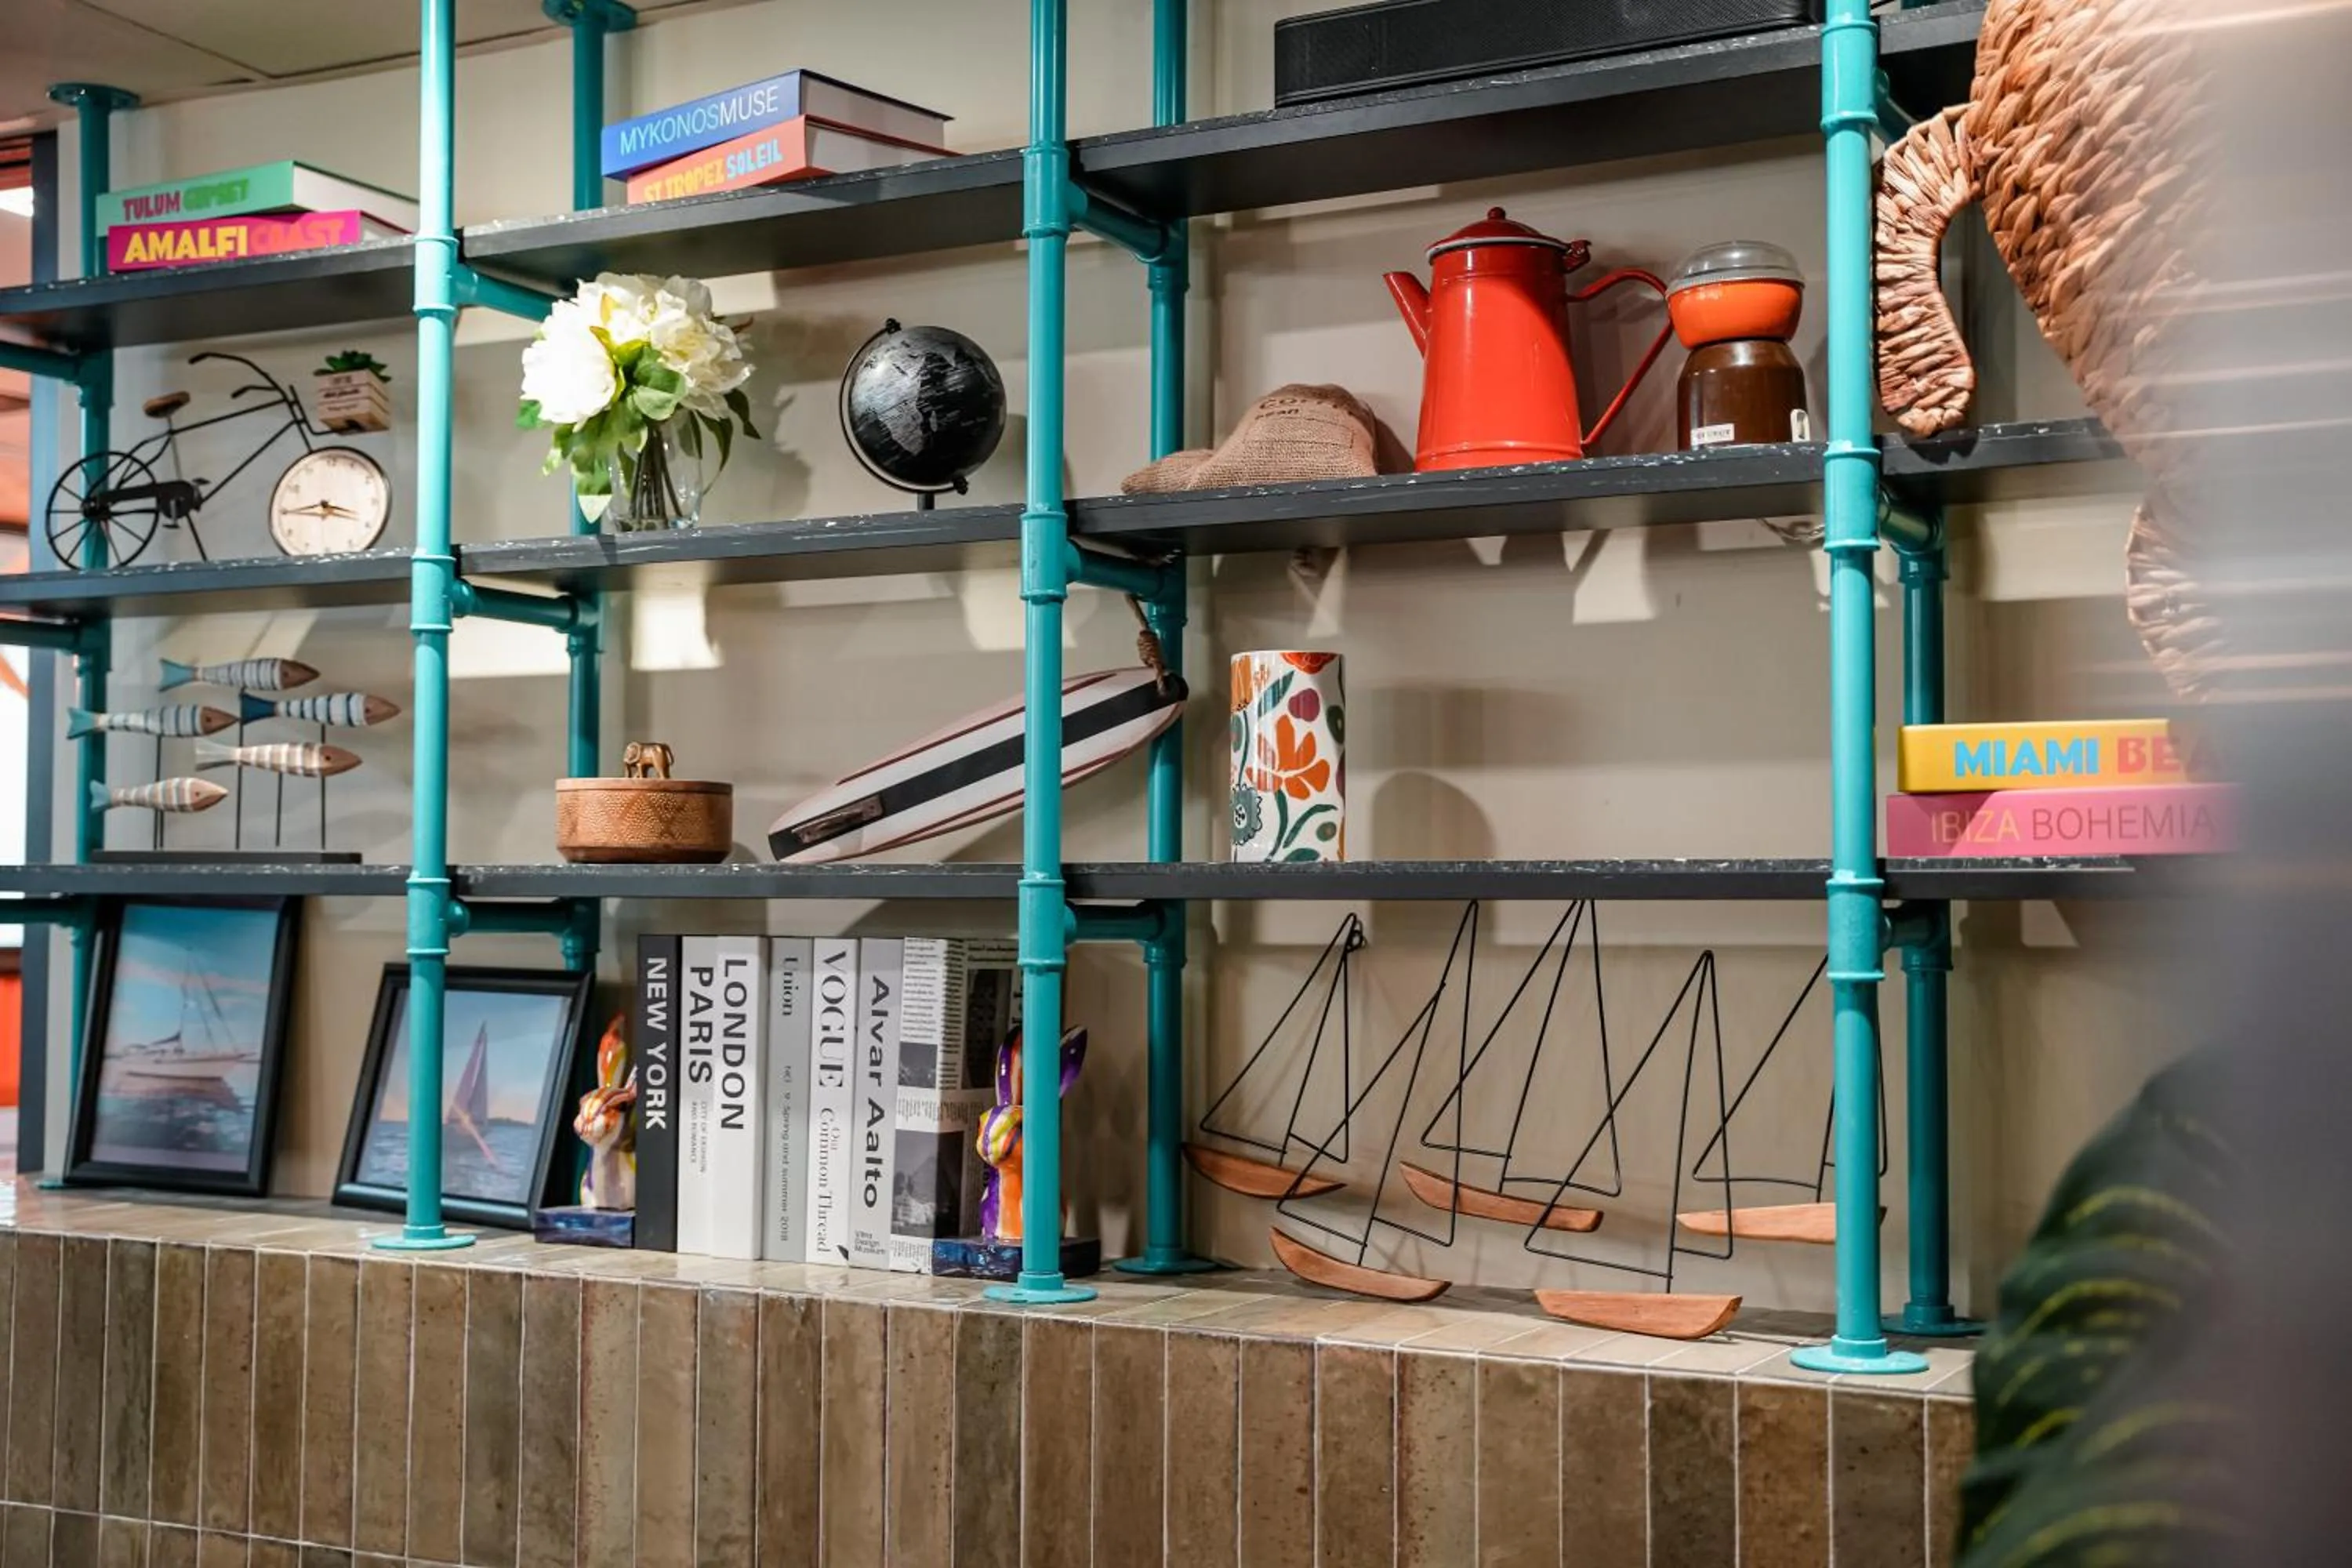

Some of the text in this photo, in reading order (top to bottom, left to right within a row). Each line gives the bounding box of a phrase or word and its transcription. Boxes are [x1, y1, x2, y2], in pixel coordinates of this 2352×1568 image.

[664, 158, 724, 199] TROPEZ
[727, 139, 782, 180] SOLEIL
[123, 191, 180, 221] TULUM
[123, 219, 344, 263] AMALFI COAST
[1955, 736, 2100, 778] MIAMI
[1931, 802, 2217, 844] IBIZA BOHEMIA
[782, 957, 798, 1015] Union
[645, 957, 667, 1130] NEW YORK
[688, 967, 713, 1083] PARIS
[720, 959, 747, 1129] LONDON
[819, 951, 847, 1087] VOGUE
[864, 975, 890, 1208] Alvar Aalto
[782, 1105, 791, 1141] Spring
[817, 1108, 834, 1252] Common Thread
